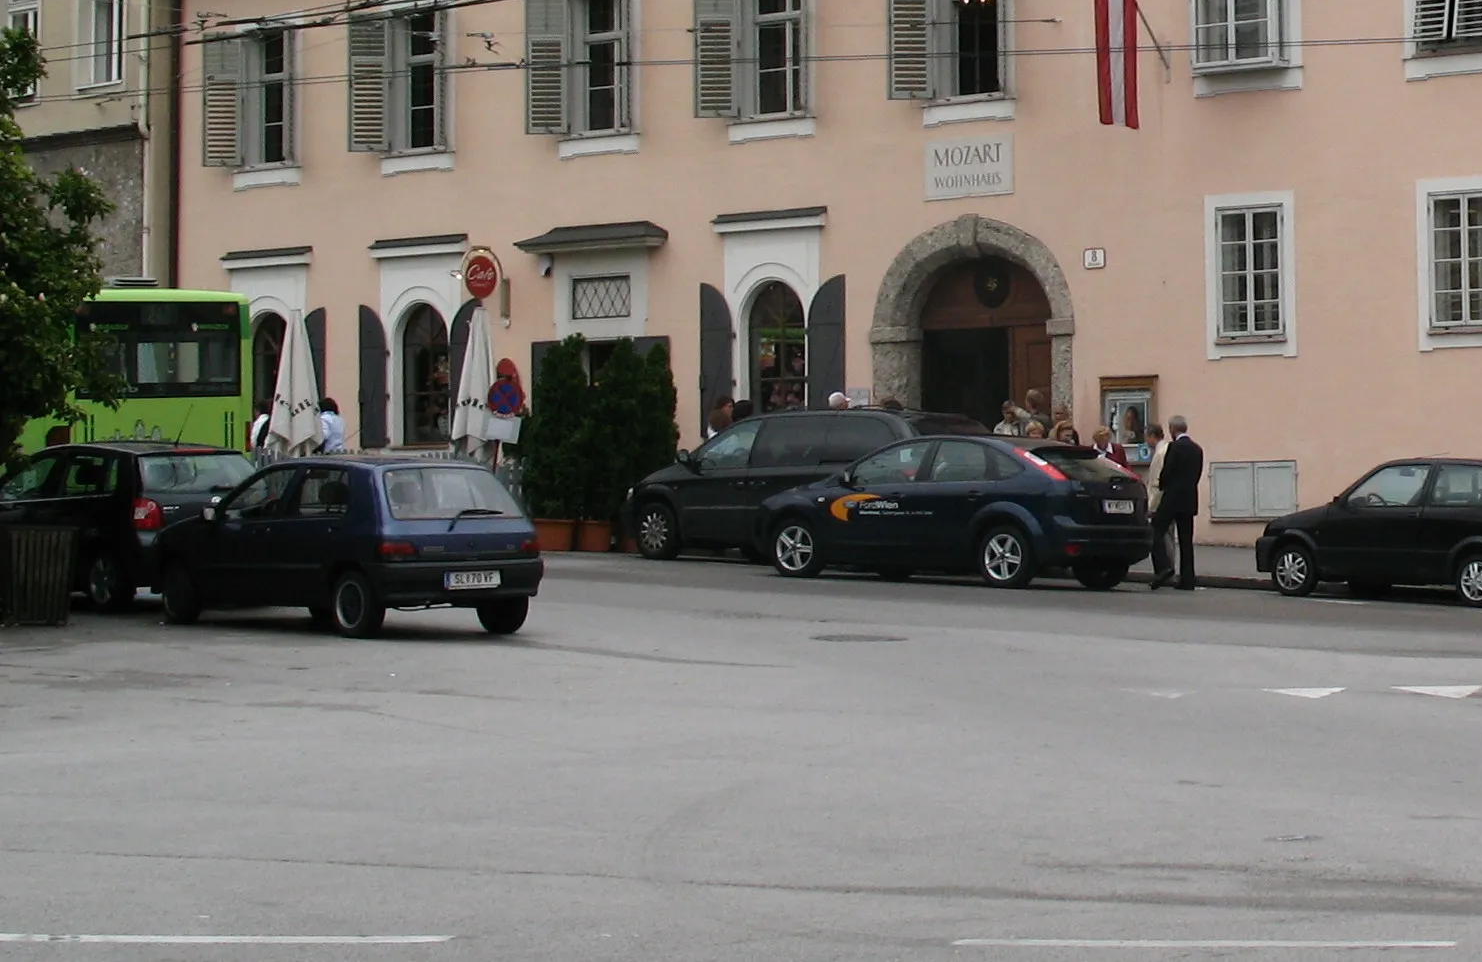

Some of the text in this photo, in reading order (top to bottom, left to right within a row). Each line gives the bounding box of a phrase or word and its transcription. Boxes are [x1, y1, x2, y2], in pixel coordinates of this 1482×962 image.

[934, 143, 1002, 167] MOZART
[934, 172, 1001, 189] WOHNHAUS
[1091, 250, 1097, 262] 8
